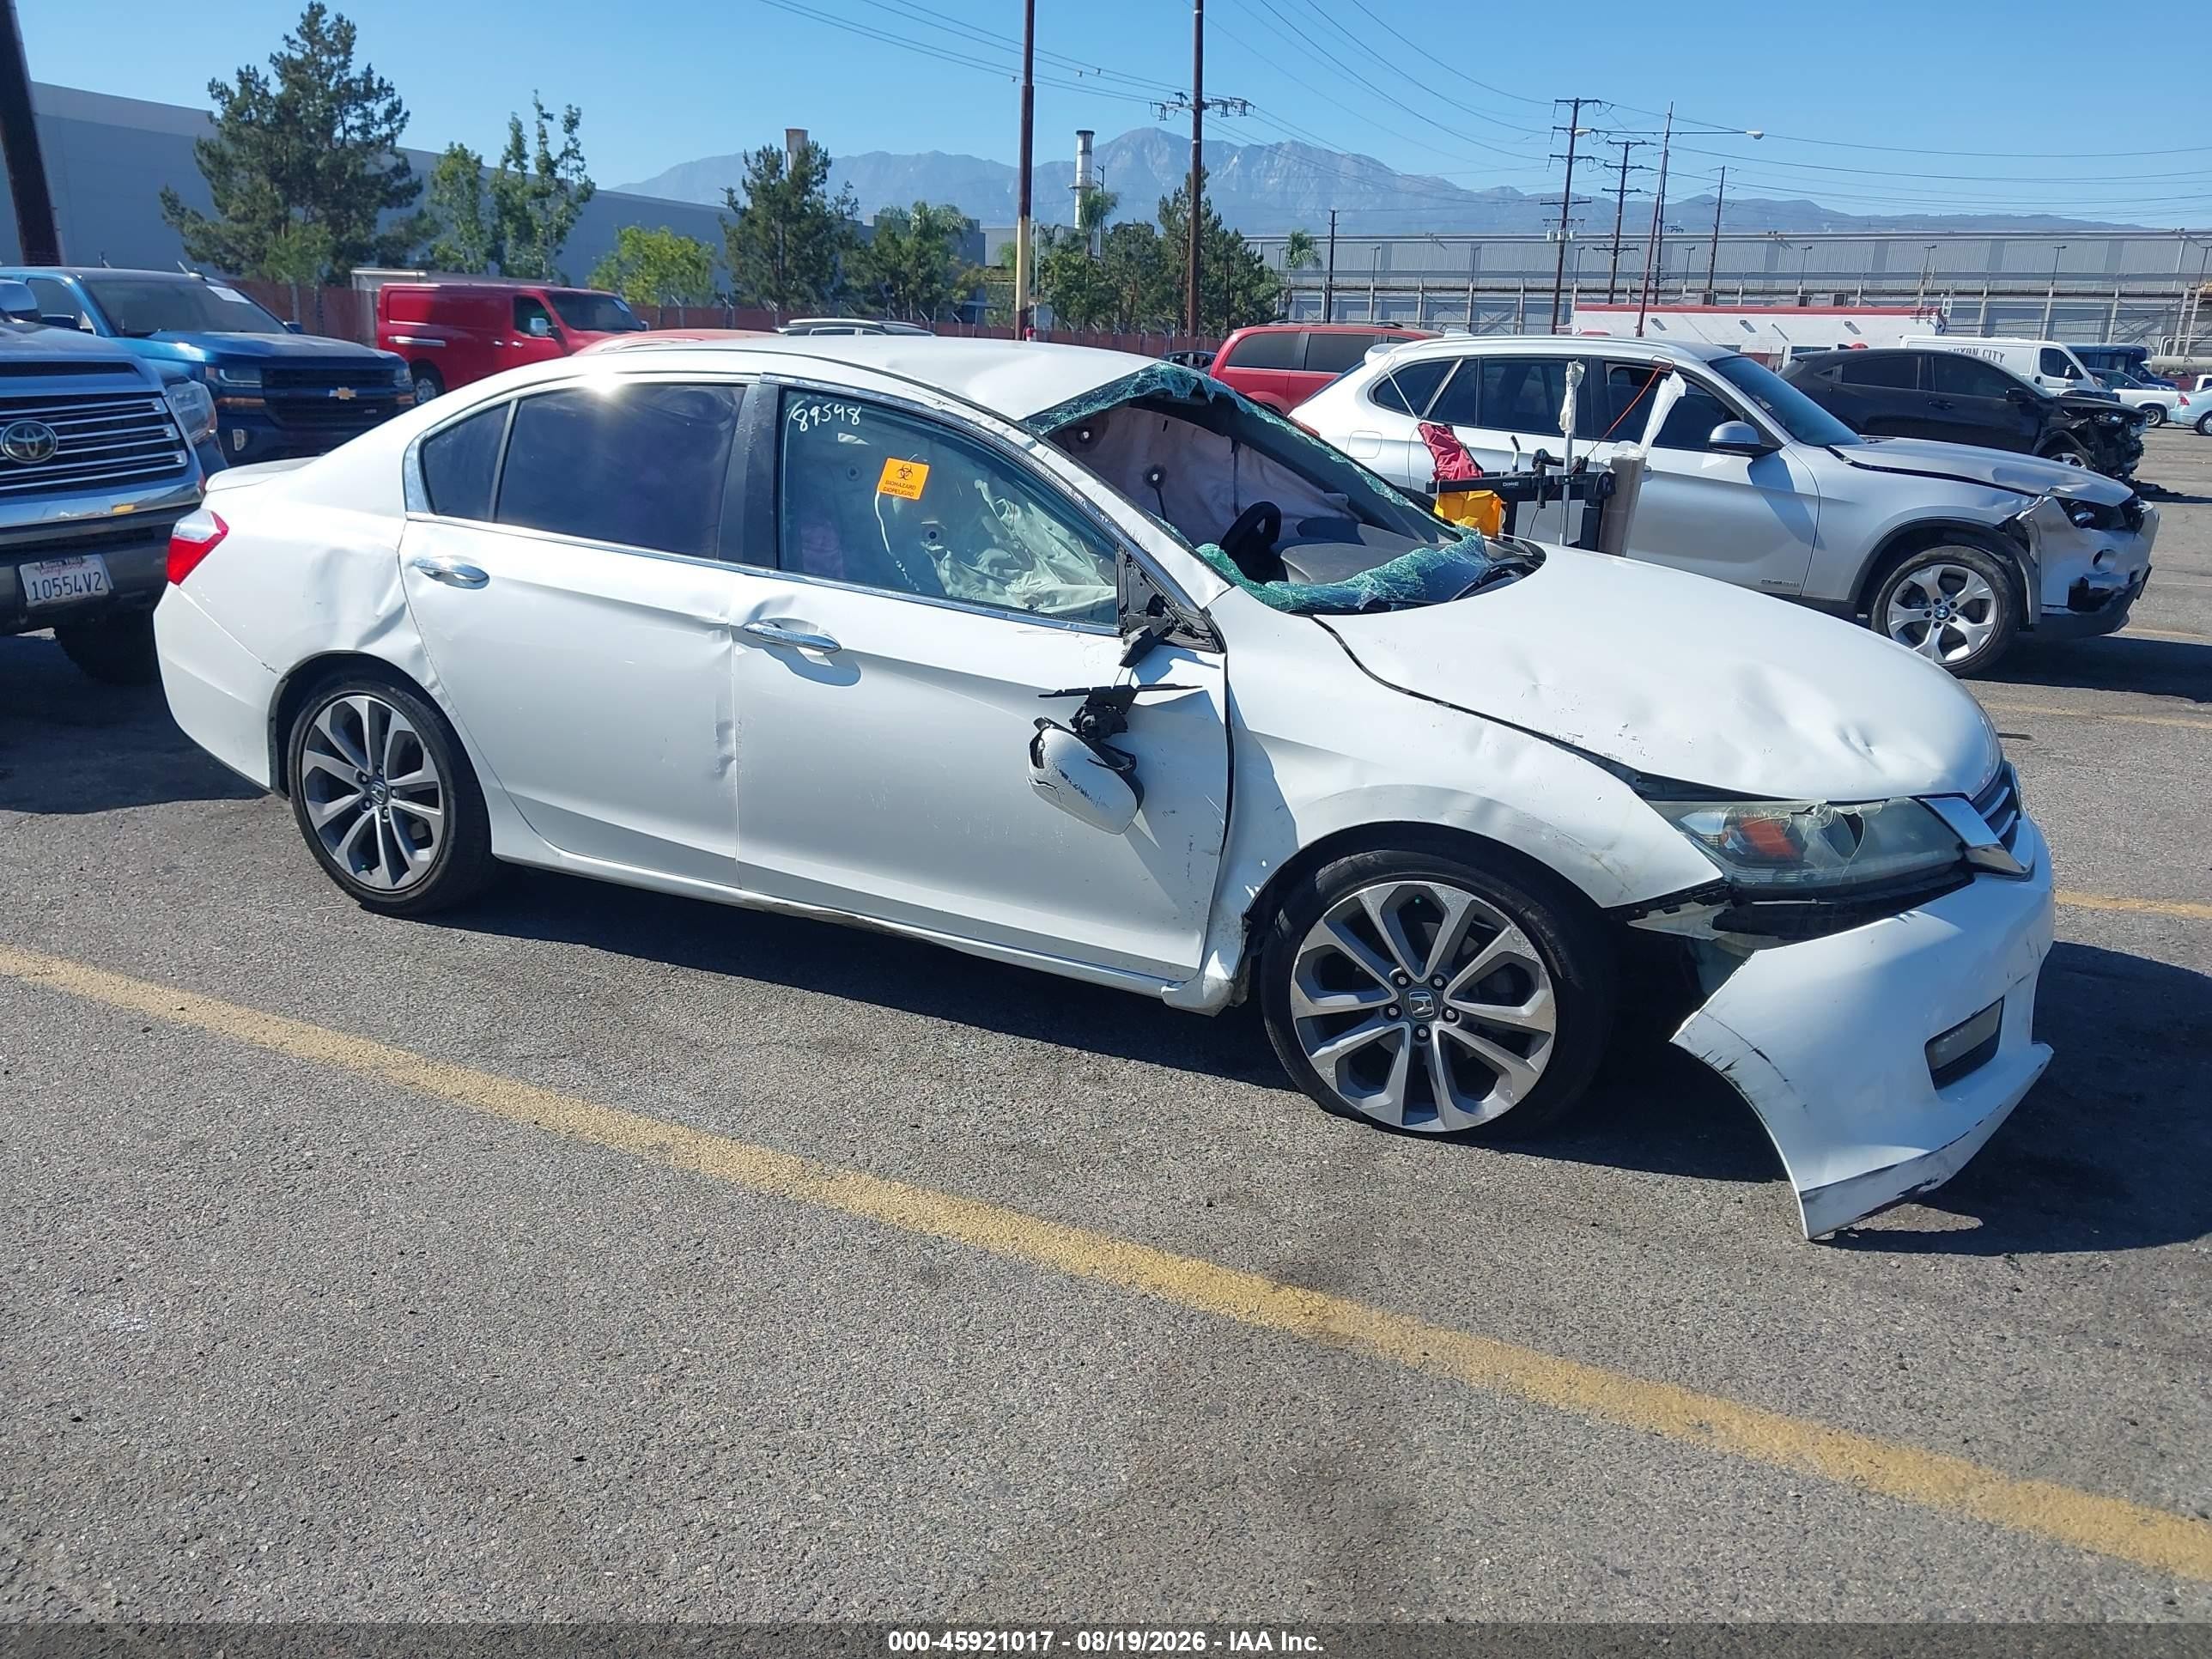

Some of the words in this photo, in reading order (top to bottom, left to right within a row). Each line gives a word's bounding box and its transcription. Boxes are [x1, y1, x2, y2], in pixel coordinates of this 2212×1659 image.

[1982, 349, 2005, 363] CITY
[885, 480, 917, 491] BIOHAZARD
[32, 571, 103, 601] 10554V2
